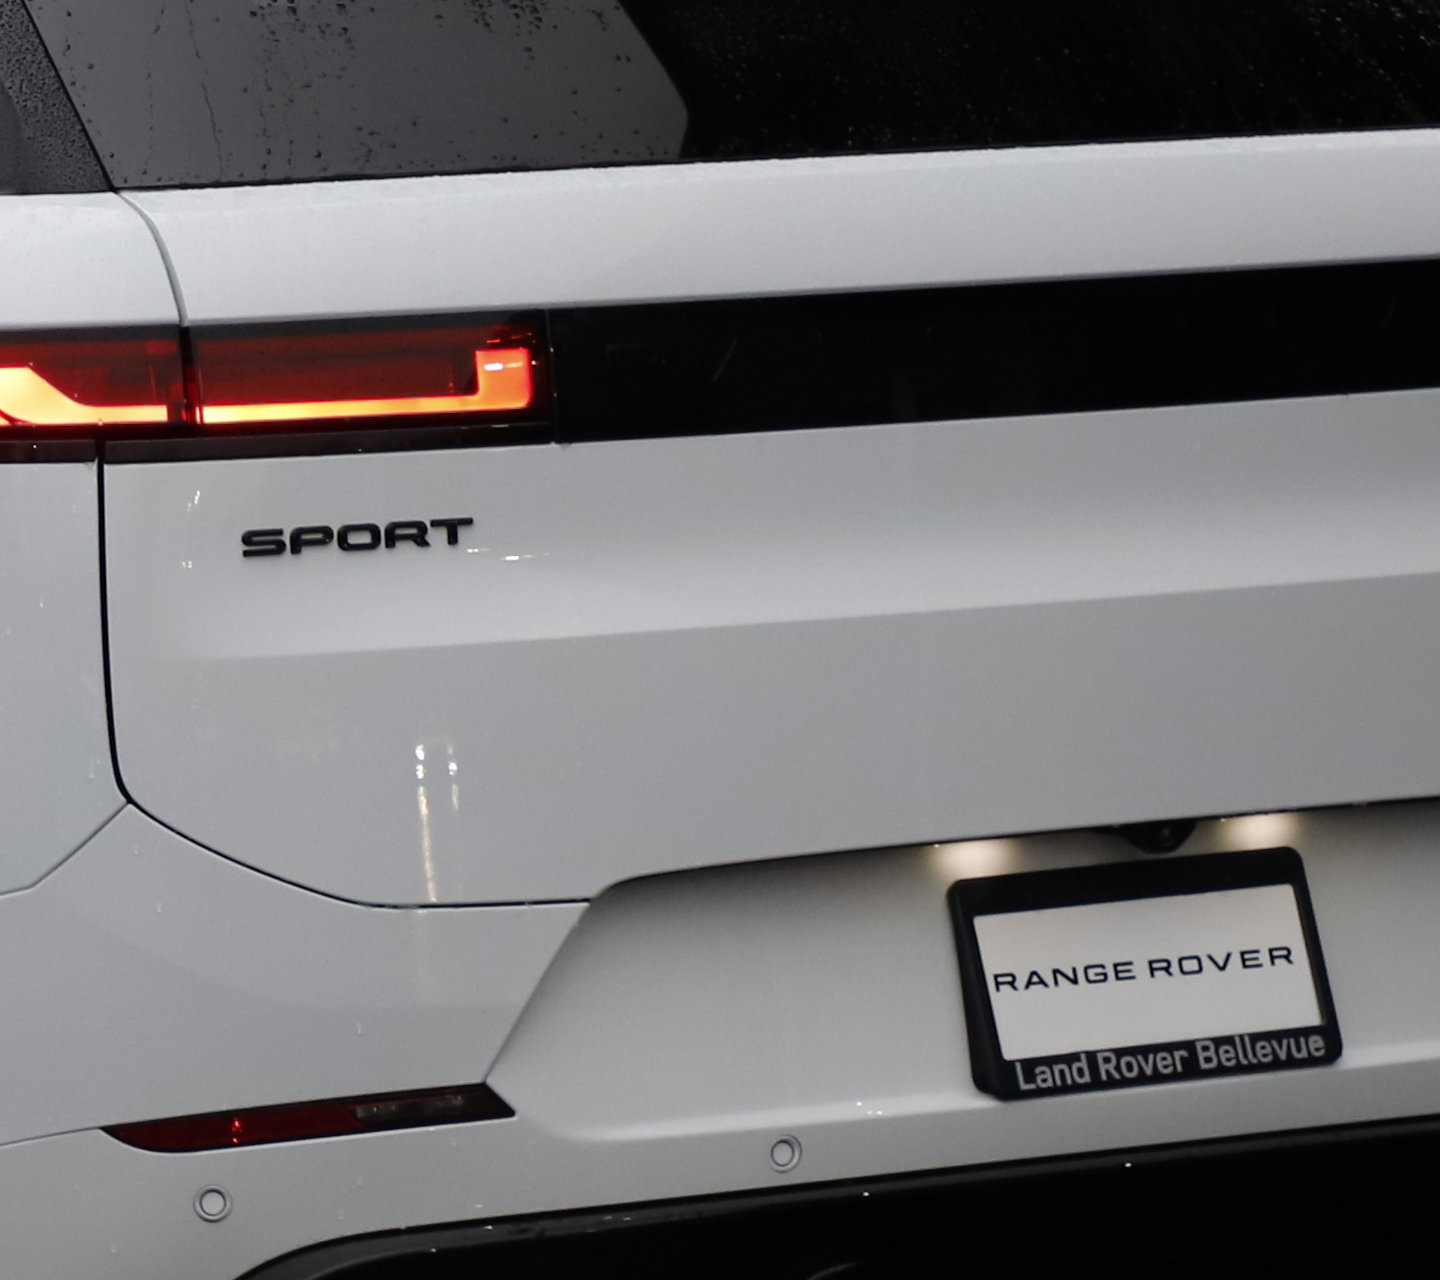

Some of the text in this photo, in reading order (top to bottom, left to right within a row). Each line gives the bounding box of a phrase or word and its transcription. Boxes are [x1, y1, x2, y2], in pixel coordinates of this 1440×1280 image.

[240, 517, 474, 558] SPORT
[992, 946, 1295, 993] RANGE ROVER
[1014, 1034, 1326, 1091] Land Rover Bellevue
